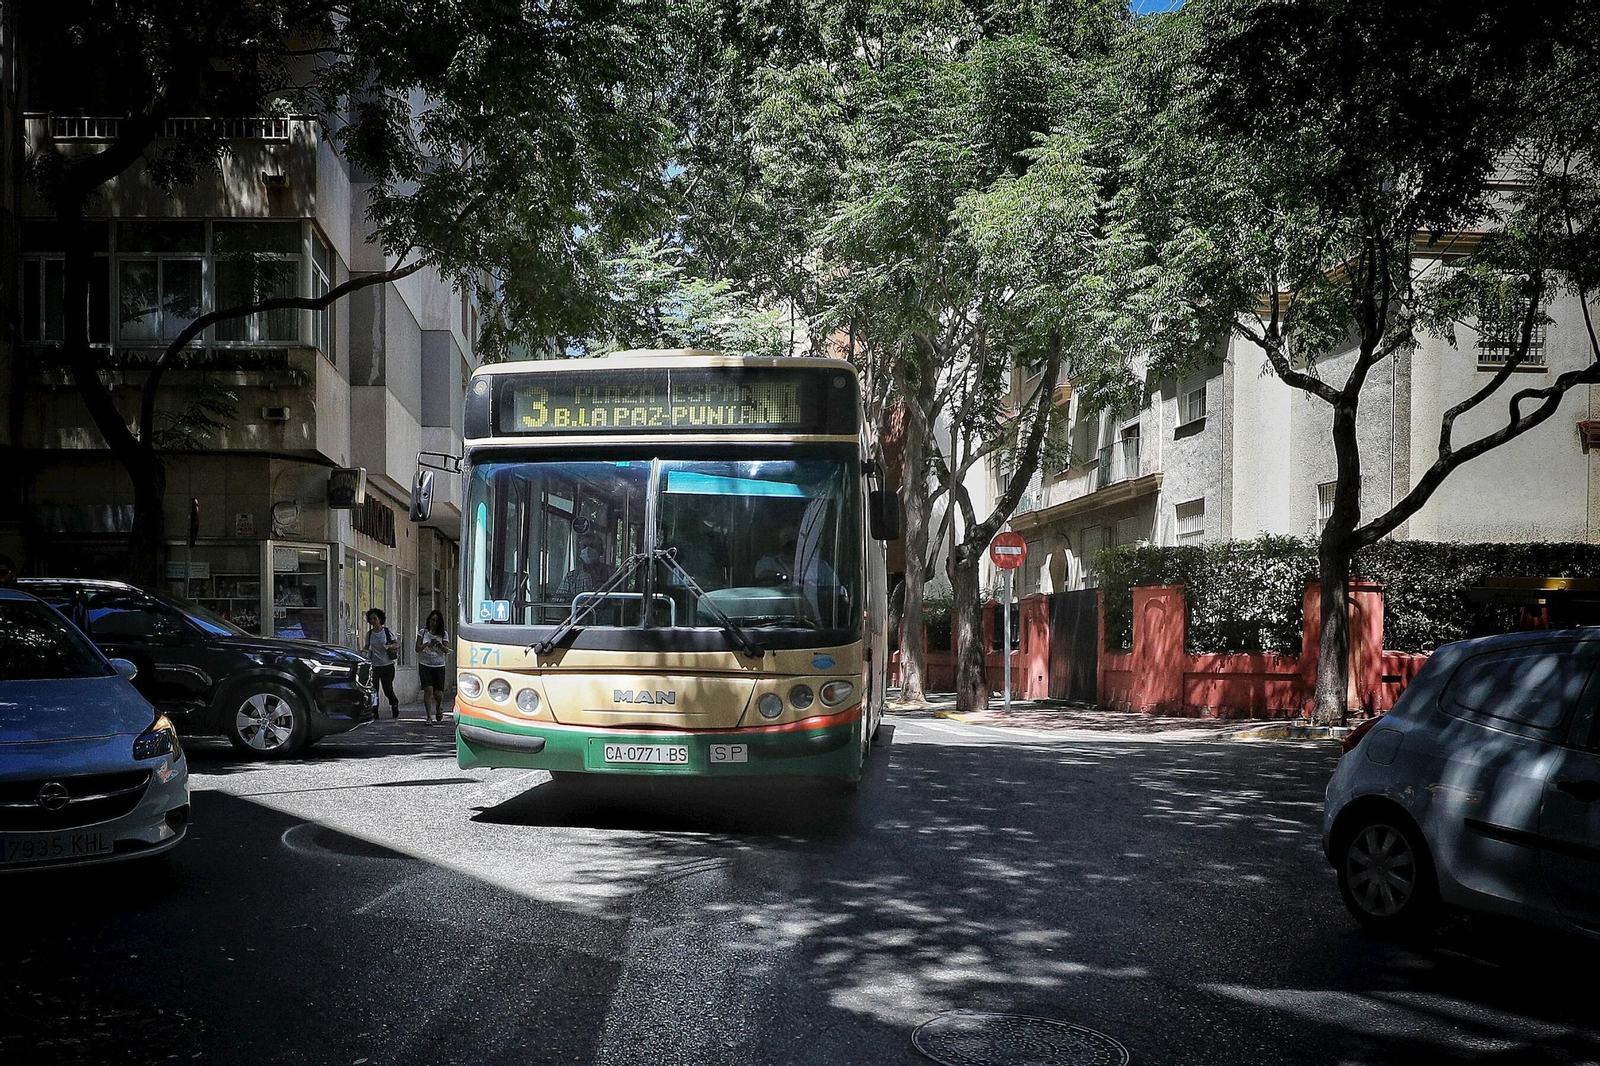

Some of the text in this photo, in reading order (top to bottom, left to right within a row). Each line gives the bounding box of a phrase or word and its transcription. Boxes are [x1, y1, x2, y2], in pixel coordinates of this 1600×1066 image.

[522, 387, 549, 427] 3
[469, 647, 501, 666] 271
[613, 689, 676, 705] MAN
[8, 833, 109, 860] 7935 KHL
